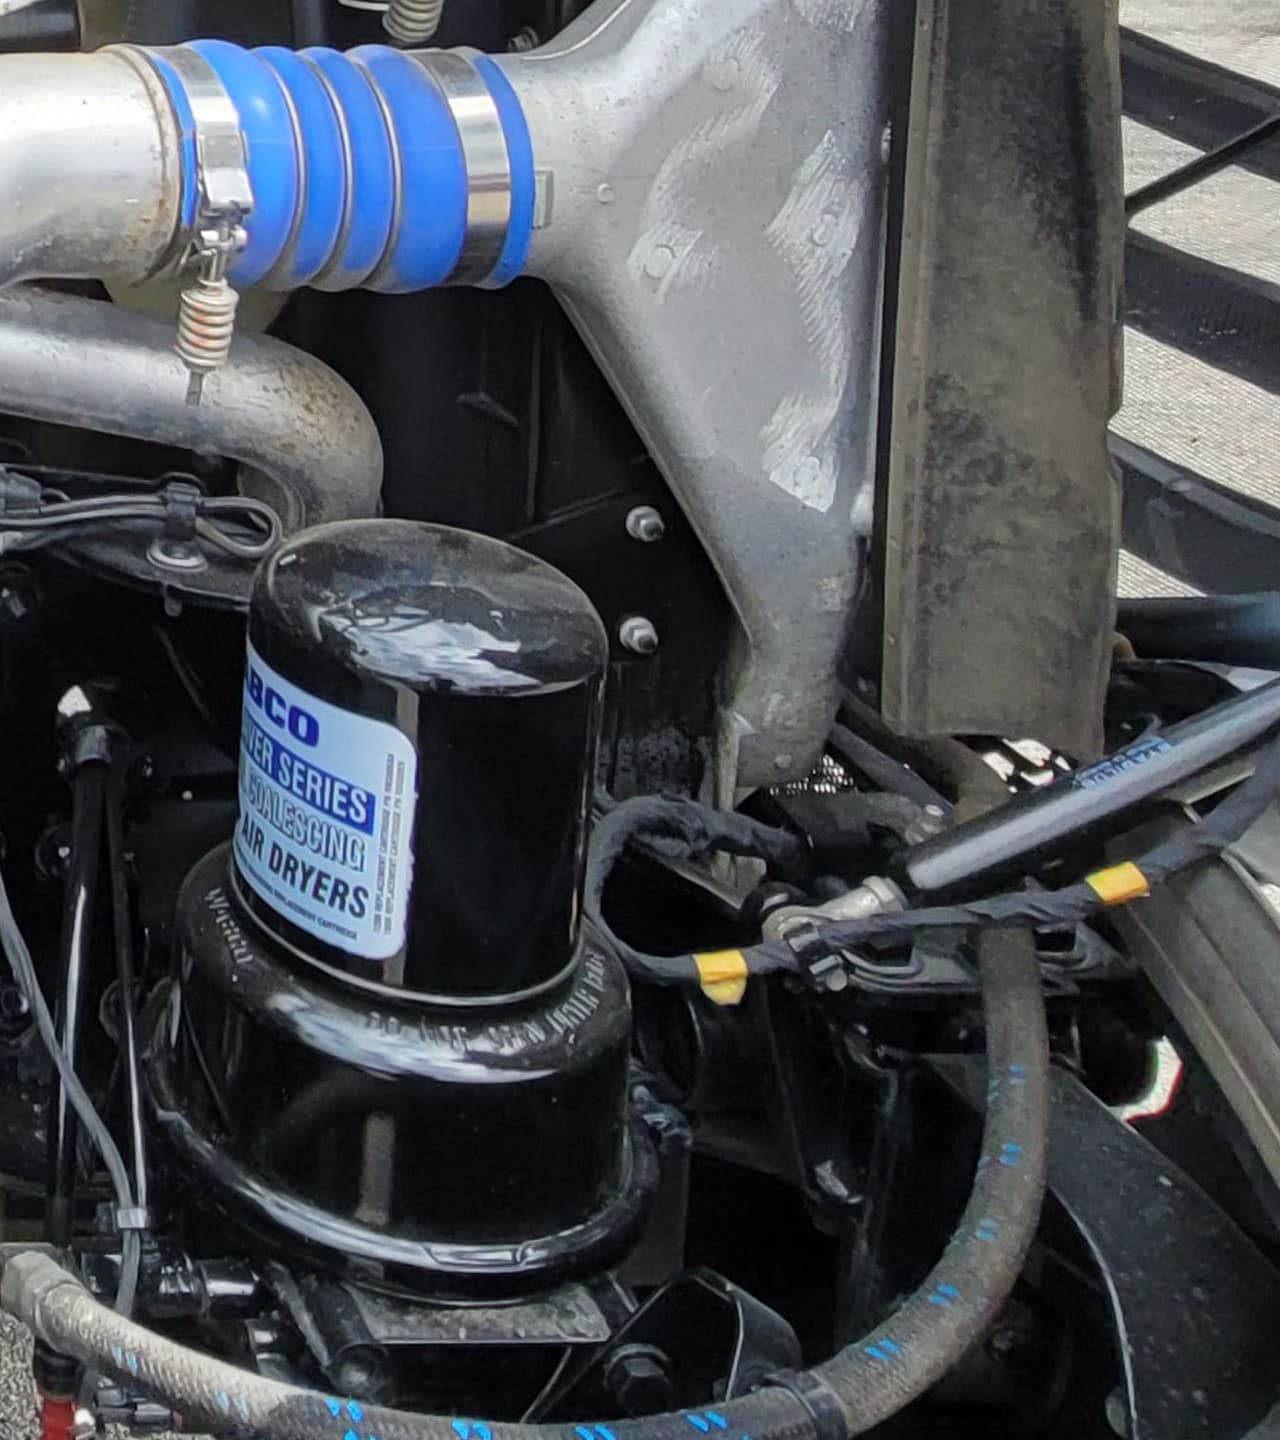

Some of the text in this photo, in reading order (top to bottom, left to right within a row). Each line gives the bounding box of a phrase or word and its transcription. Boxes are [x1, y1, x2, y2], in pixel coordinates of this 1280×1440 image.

[246, 664, 320, 748] BCO
[247, 773, 366, 873] COALESCING
[277, 752, 369, 825] SERIES
[240, 812, 266, 861] AIR
[268, 840, 370, 919] DRYERS
